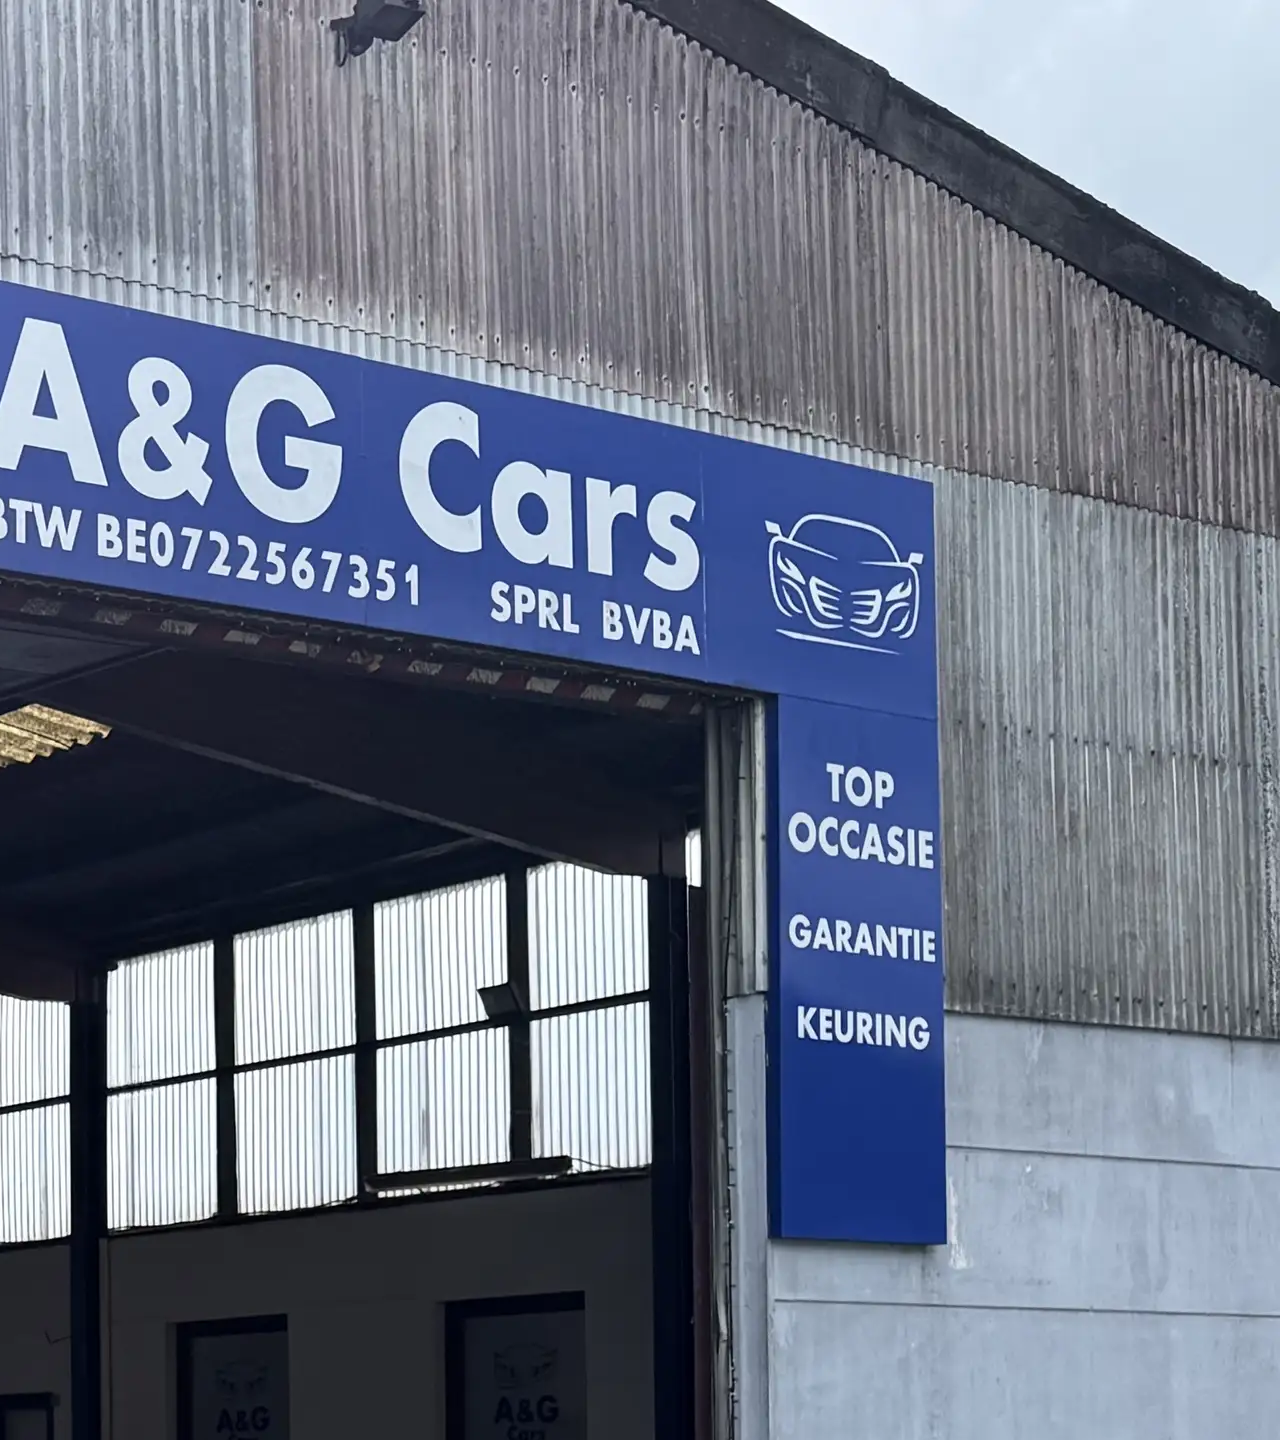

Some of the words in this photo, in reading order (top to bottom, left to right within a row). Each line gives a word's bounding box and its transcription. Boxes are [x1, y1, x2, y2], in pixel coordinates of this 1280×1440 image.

[398, 400, 701, 593] Cars
[97, 513, 420, 606] BE0722567351
[490, 580, 580, 634] SPRL
[602, 600, 701, 656] BVBA
[826, 762, 895, 809] TOP
[788, 811, 934, 870] OCCASIE
[788, 914, 936, 963] GARANTIE
[797, 1005, 931, 1051] KEURING
[216, 1404, 271, 1433] A&G
[493, 1394, 560, 1425] A&G
